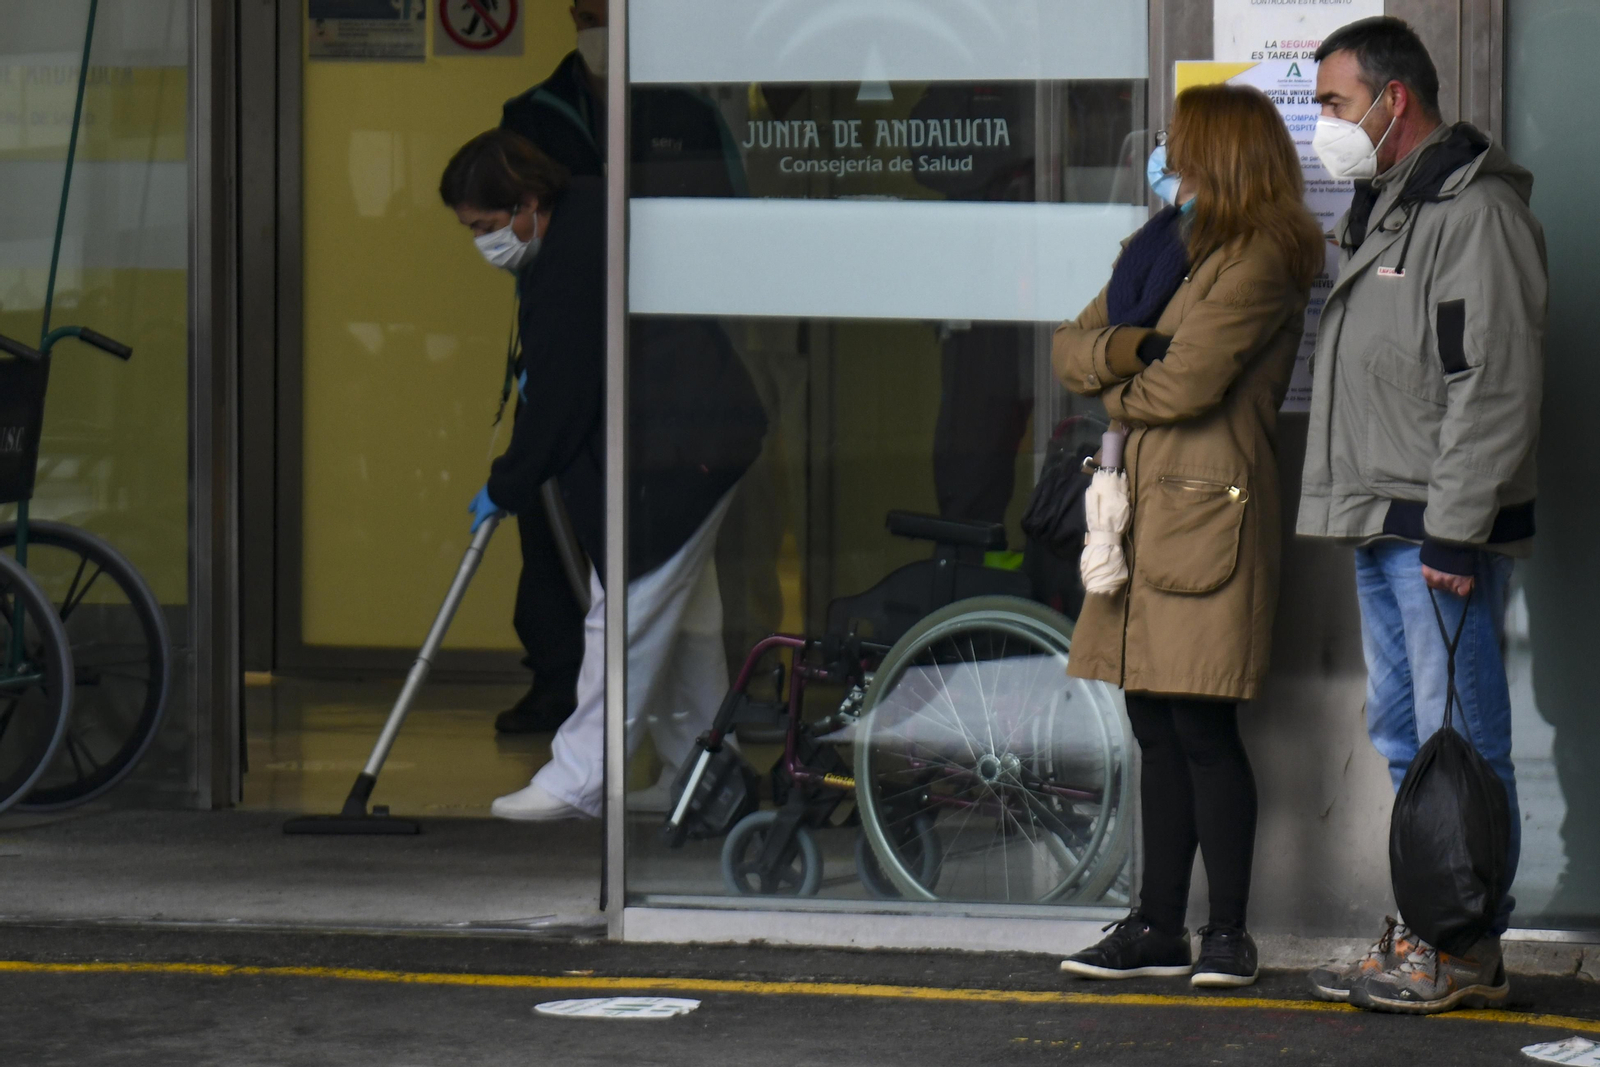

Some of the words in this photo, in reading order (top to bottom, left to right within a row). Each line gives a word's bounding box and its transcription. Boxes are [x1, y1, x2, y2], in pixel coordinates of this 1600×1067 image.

[1265, 40, 1277, 48] LA
[1251, 51, 1264, 60] ES
[1267, 51, 1299, 60] TAREA
[1287, 97, 1295, 105] DE
[1297, 97, 1309, 105] LAS
[742, 120, 820, 148] JUNTA
[832, 120, 862, 148] DE
[875, 118, 1011, 147] ANDALUCIA
[780, 155, 883, 177] Consejería
[888, 156, 913, 172] de
[918, 155, 973, 172] Salud
